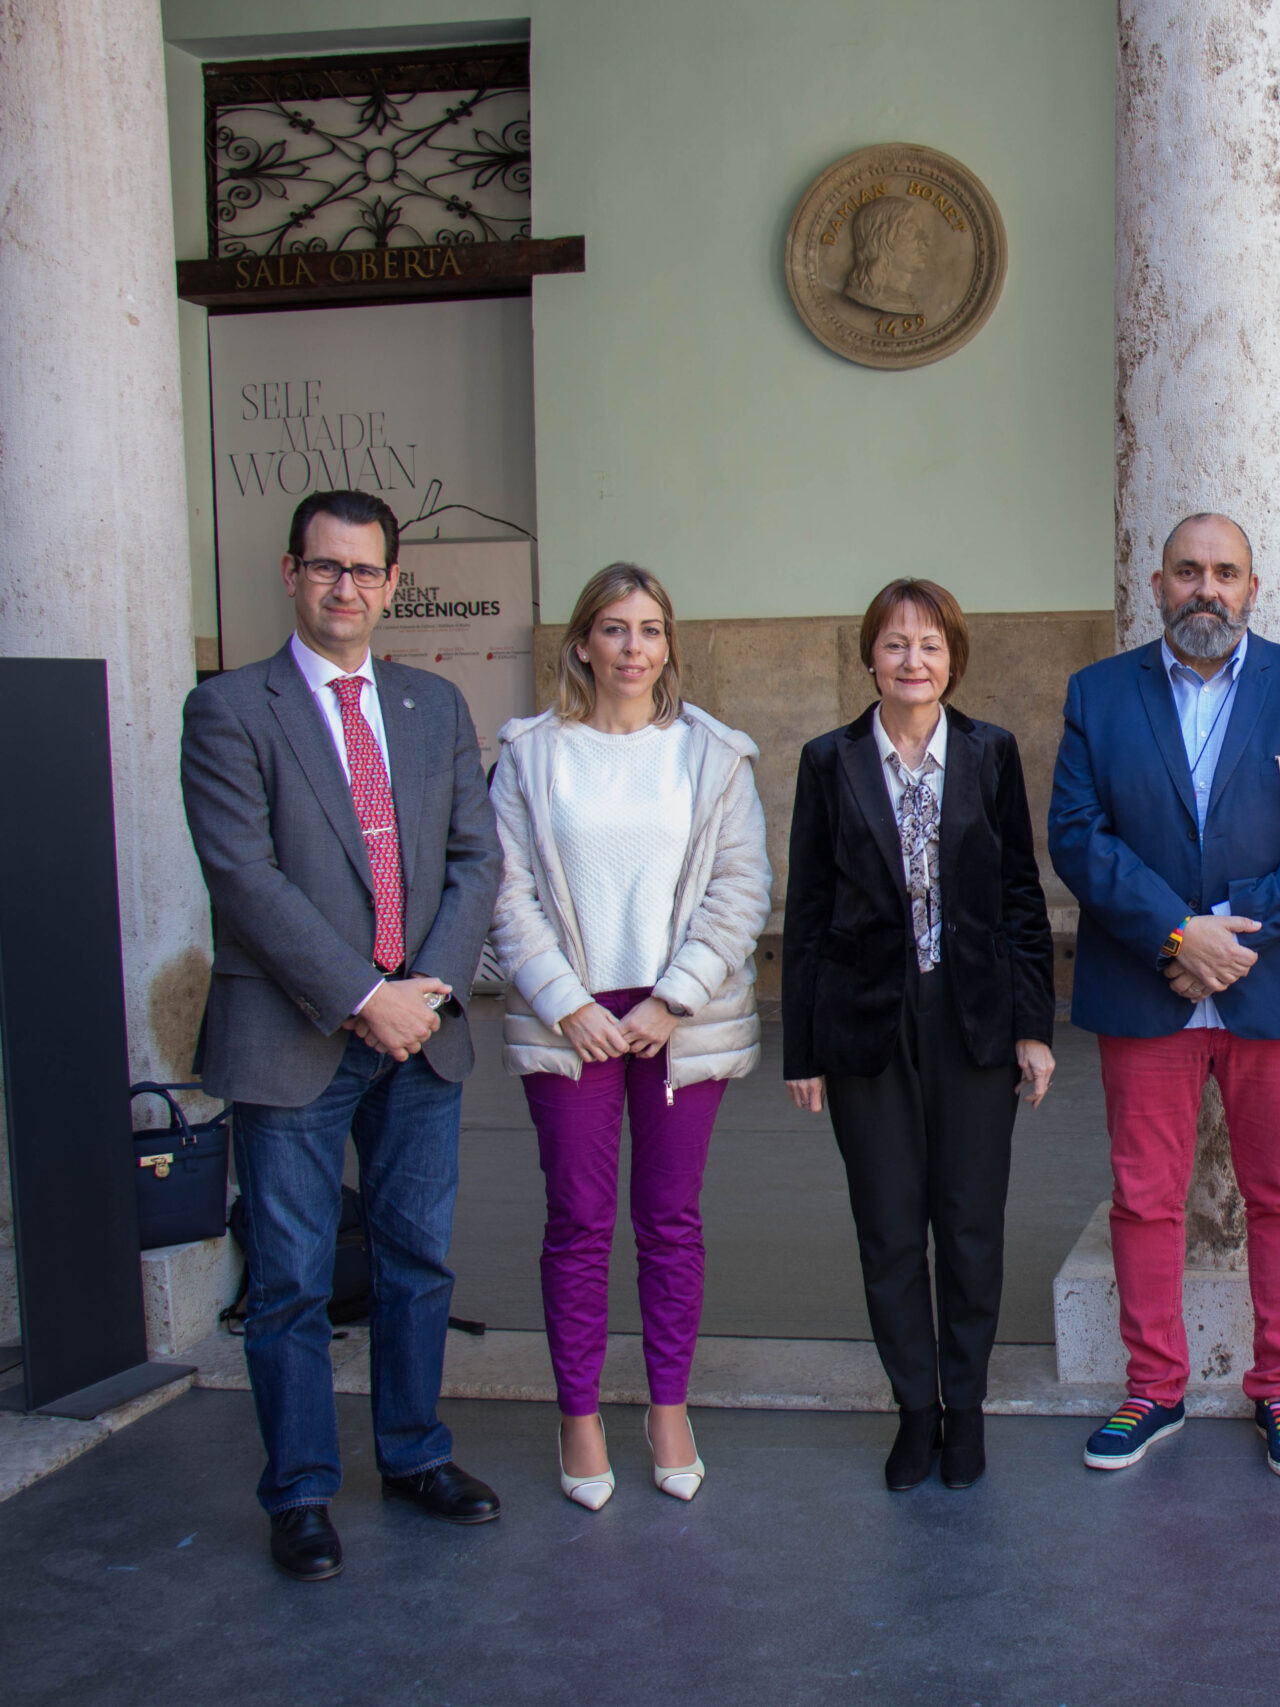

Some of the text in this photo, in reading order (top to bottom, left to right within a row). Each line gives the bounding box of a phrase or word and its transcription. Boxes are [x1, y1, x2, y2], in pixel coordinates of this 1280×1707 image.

[821, 180, 969, 247] DAMIAN BONET
[236, 248, 462, 289] SALA OBERTA
[874, 315, 927, 337] 1499
[241, 380, 321, 421] SELF
[278, 412, 387, 453] MADE
[228, 444, 416, 497] WOMAN
[391, 587, 440, 602] NENT
